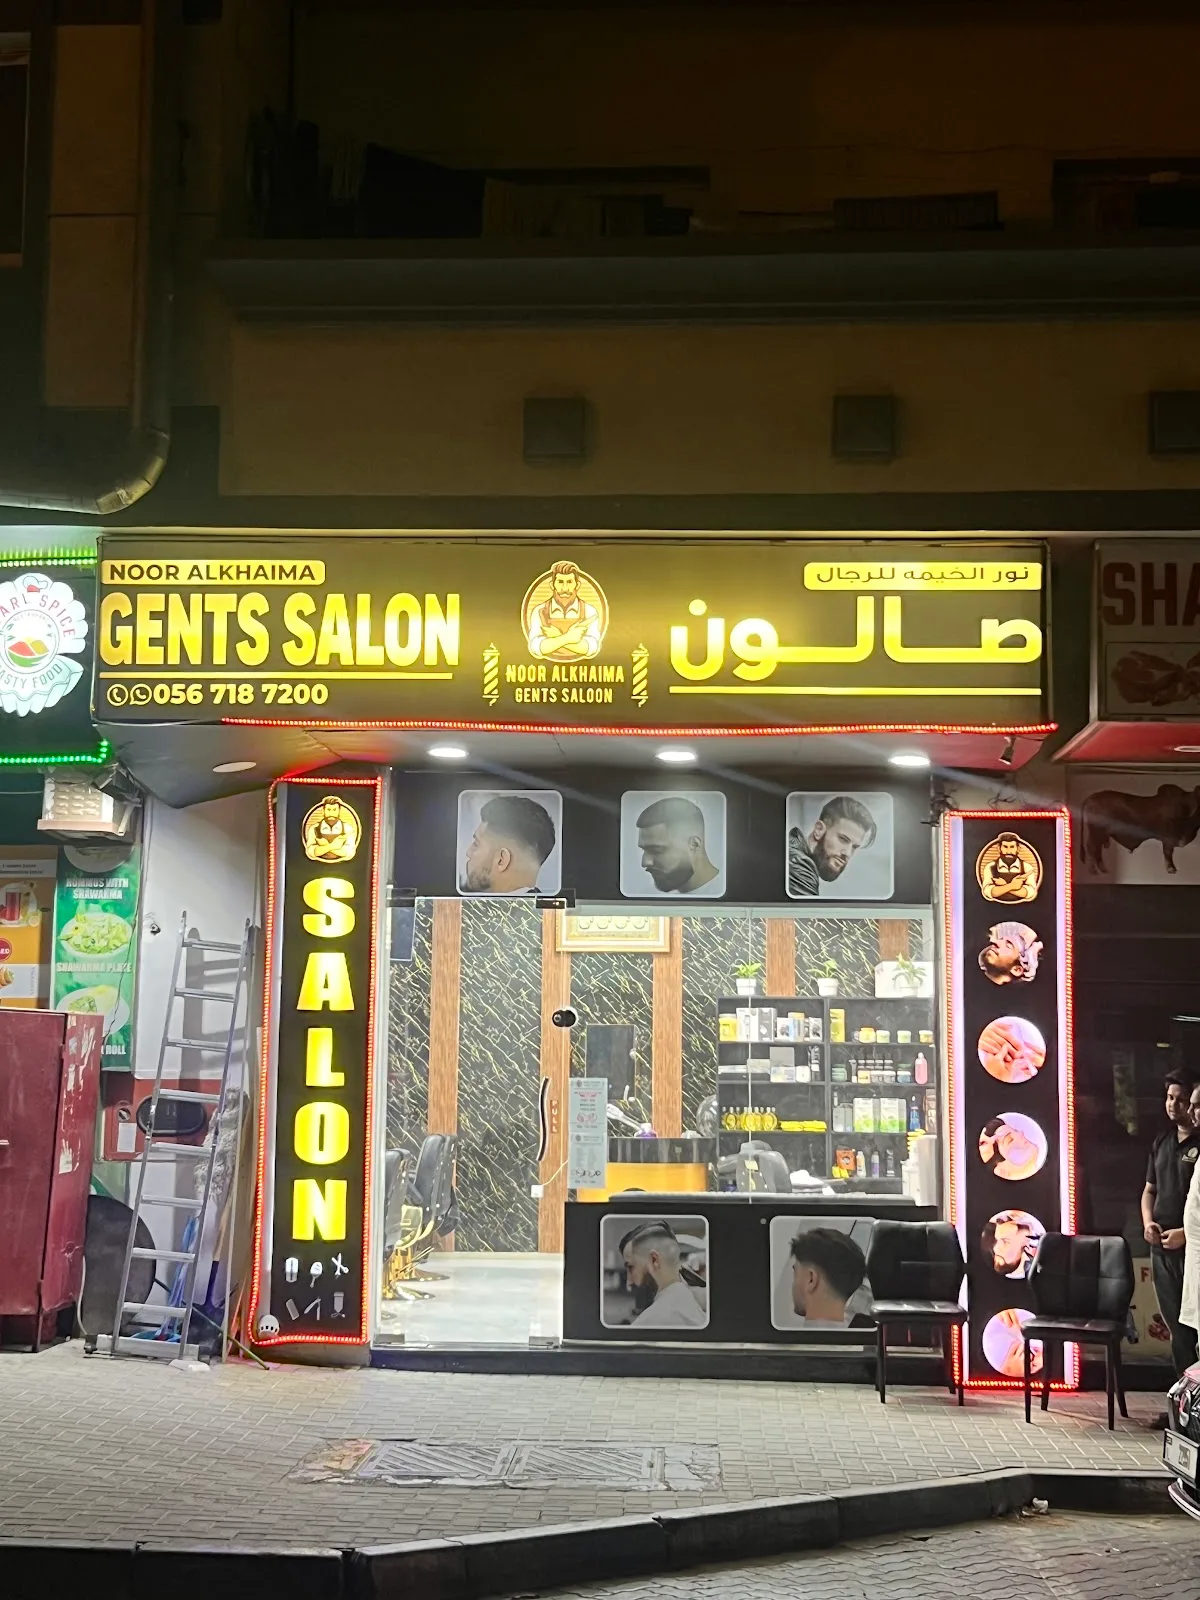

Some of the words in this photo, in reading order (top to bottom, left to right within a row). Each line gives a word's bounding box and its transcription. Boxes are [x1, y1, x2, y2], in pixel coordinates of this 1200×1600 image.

[109, 564, 180, 582] NOOR
[187, 564, 317, 582] ALKHAIMA
[815, 566, 896, 584] للرجال
[991, 566, 1030, 584] نور
[39, 593, 76, 638] SPICE
[98, 591, 270, 667] GENTS
[281, 591, 461, 667] SALON
[669, 594, 1043, 682] صالون
[32, 663, 63, 689] FOOD
[504, 663, 547, 684] NOOR
[551, 664, 626, 684] ALKHAIMA
[152, 683, 205, 706] 056
[209, 683, 255, 706] 718
[261, 683, 329, 706] 7200
[514, 687, 558, 704] GENTS
[561, 687, 614, 704] SALOON
[105, 878, 129, 888] WITH
[105, 1044, 126, 1055] ROLL
[293, 876, 356, 1242] SALON
